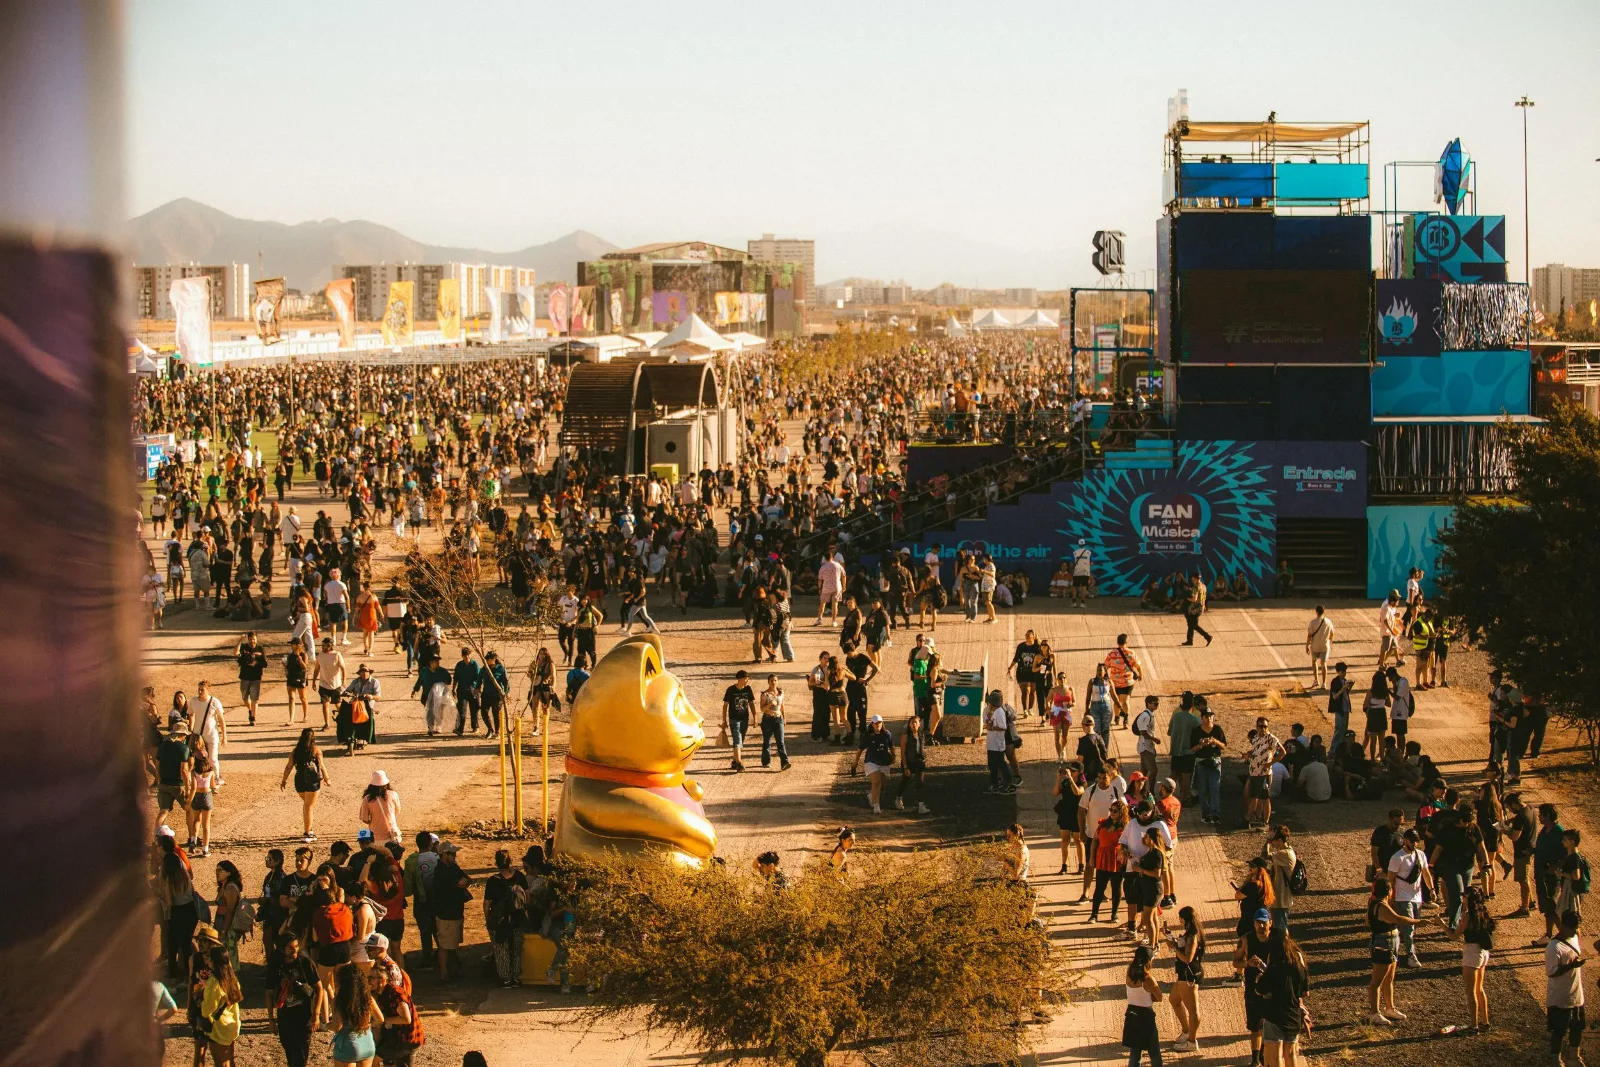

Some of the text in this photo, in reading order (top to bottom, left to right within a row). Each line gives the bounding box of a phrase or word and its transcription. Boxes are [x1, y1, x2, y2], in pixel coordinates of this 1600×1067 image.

[1283, 465, 1357, 480] Entrada
[1148, 504, 1193, 519] FAN
[1141, 525, 1201, 538] Música
[990, 544, 1021, 558] the
[1025, 544, 1052, 558] air
